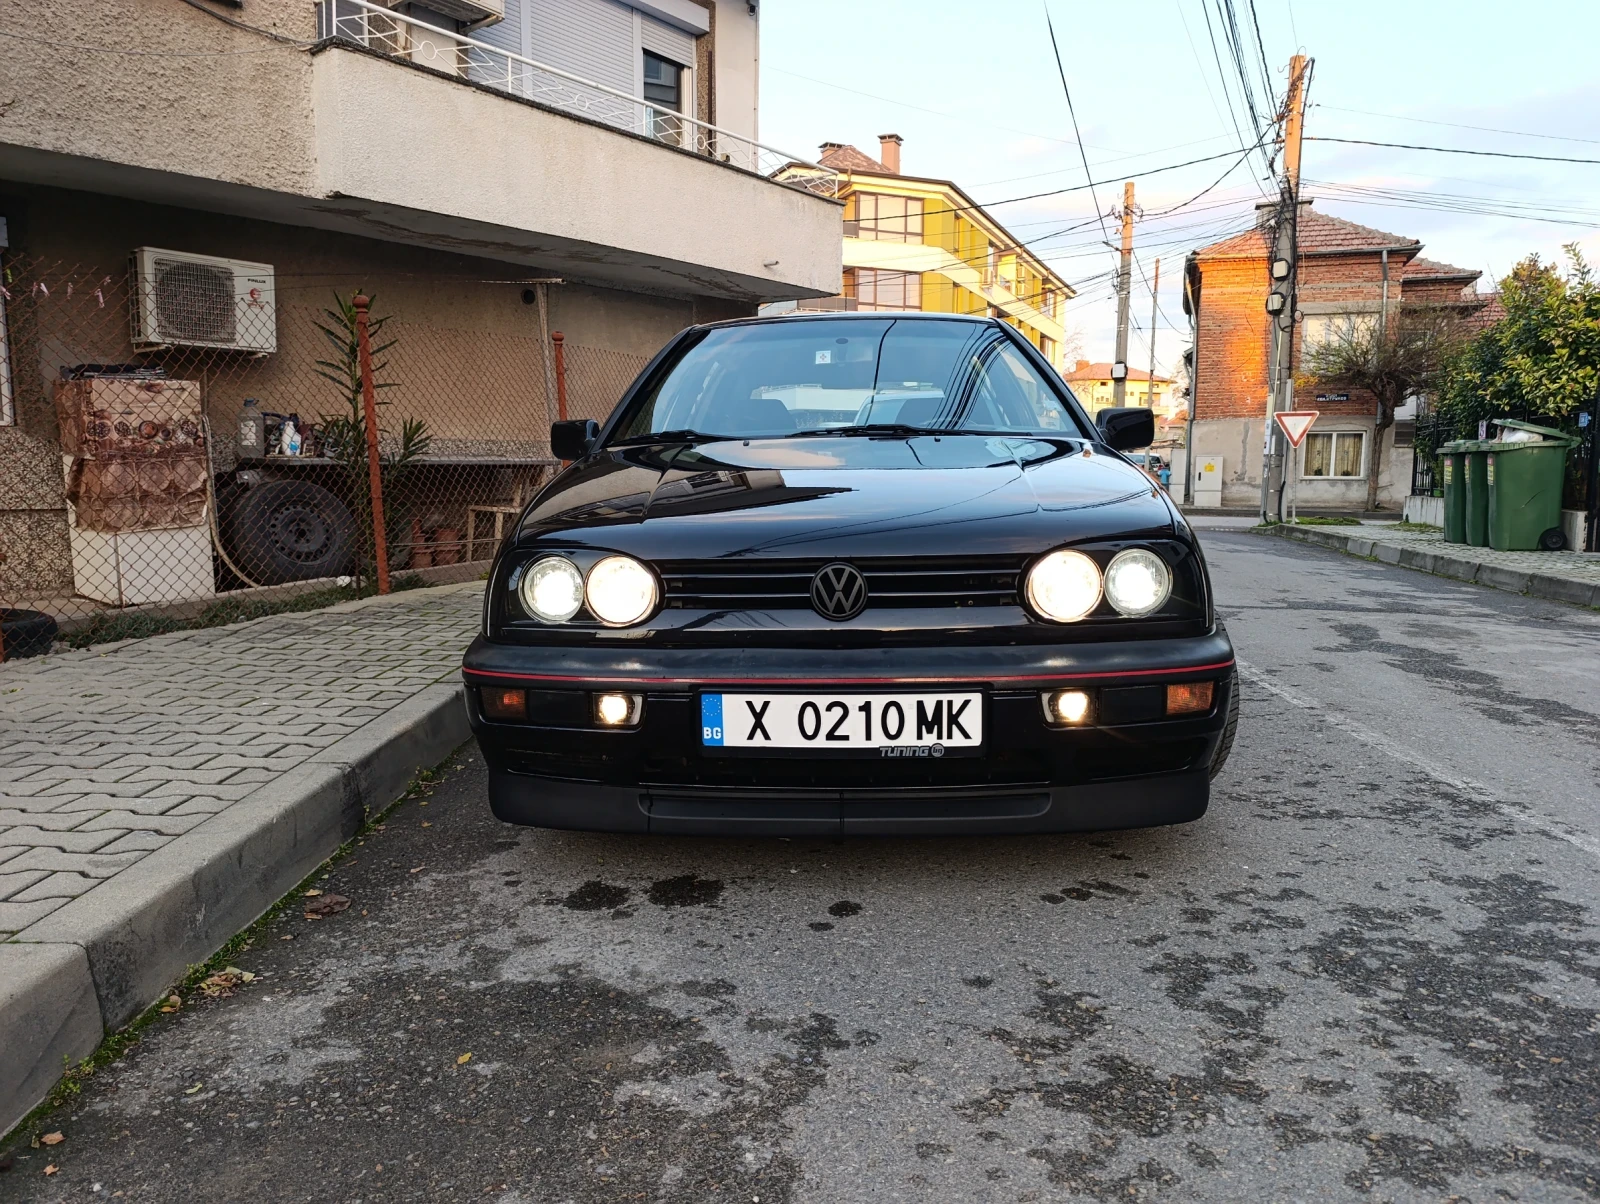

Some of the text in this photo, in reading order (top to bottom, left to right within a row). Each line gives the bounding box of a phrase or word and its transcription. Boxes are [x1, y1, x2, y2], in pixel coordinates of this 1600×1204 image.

[745, 699, 972, 741] X 0210 MK
[703, 726, 722, 740] BG
[879, 746, 930, 757] TUNING
